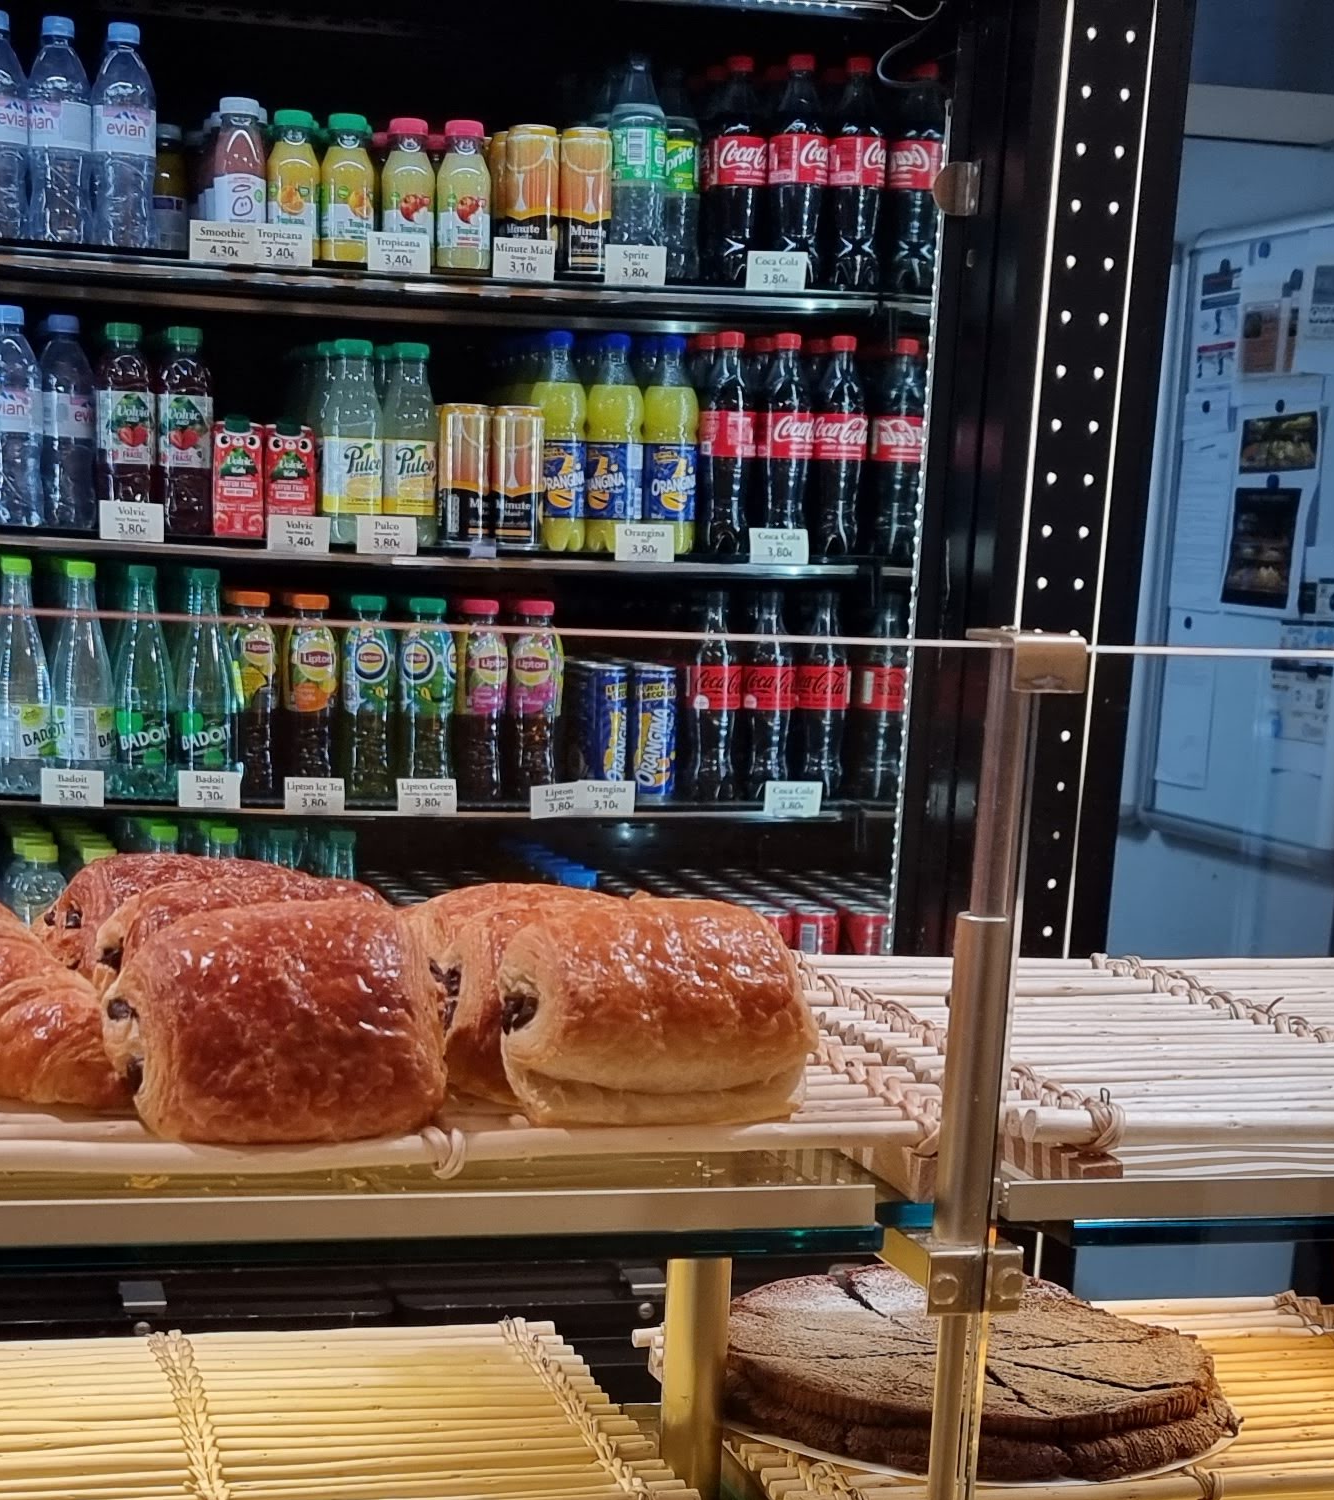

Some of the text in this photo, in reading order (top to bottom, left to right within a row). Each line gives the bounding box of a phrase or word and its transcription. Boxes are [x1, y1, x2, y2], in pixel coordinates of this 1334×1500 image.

[28, 115, 54, 130] vian
[106, 121, 146, 138] evian
[666, 147, 693, 176] prite
[200, 227, 246, 239] Smoothie
[257, 229, 303, 241] Tropicana
[376, 237, 420, 248] Tropicana
[265, 246, 295, 260] 3,40€
[495, 242, 553, 255] Minute Maid
[623, 251, 650, 264] Sprite
[755, 256, 799, 267] Coca Cola
[344, 445, 381, 474] Pulco
[395, 447, 435, 475] Pulco
[117, 506, 146, 516] Volvic
[286, 521, 313, 530] Volvic
[374, 521, 400, 530] Pulco
[624, 529, 665, 539] Orangina
[302, 652, 332, 664] Lipton
[518, 660, 546, 671] Lipton
[119, 723, 171, 751] BADOIT
[181, 723, 232, 751] BADOIT
[58, 774, 87, 783] Badoit
[195, 775, 225, 784] Badoit
[287, 783, 342, 792] Lipton Ice Tea
[401, 783, 454, 792] Lipton Green
[587, 785, 626, 795] Orangina
[545, 788, 574, 799] Lipton
